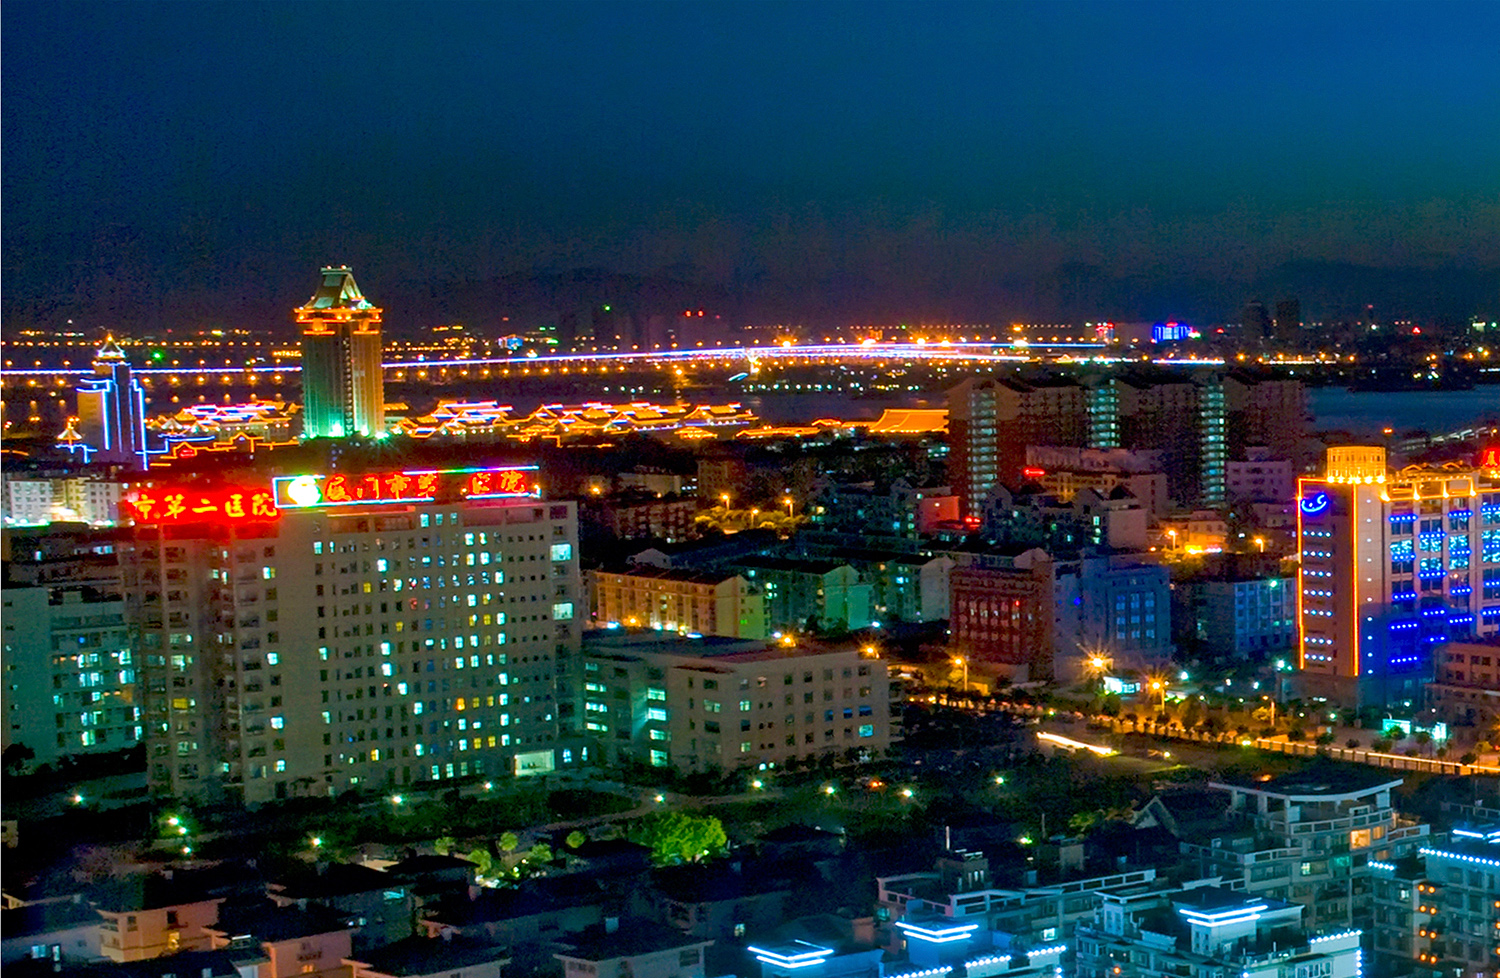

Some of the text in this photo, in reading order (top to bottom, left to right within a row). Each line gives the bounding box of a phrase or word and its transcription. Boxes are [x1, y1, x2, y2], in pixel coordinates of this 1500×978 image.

[325, 470, 527, 500] 厦门市第医院
[132, 492, 278, 520] 市第二医院
